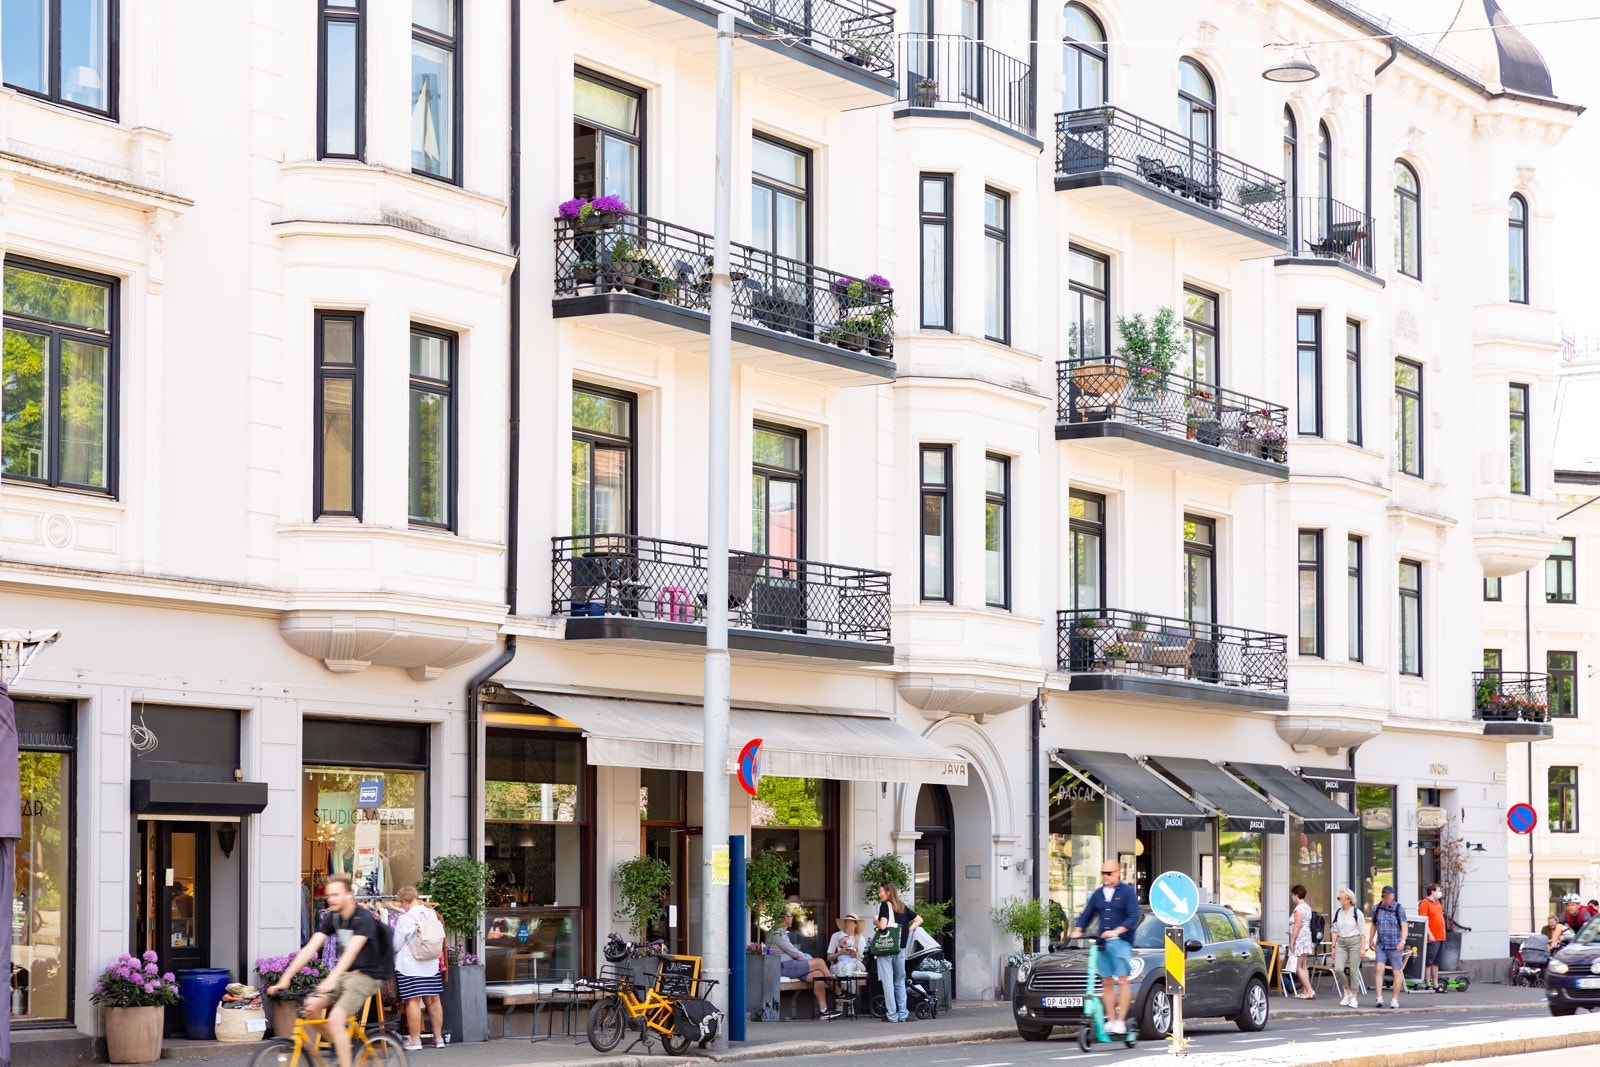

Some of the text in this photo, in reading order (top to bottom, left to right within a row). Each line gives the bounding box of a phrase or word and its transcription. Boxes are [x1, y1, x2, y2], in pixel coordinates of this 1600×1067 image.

[943, 764, 965, 775] JAVA
[1057, 785, 1095, 805] PASCAL
[313, 808, 404, 826] STUDIOBAZAR
[1164, 817, 1183, 828] PASCAL
[1249, 820, 1265, 830] PASCAL
[1324, 822, 1340, 832] PASCAL
[1047, 998, 1081, 1006] DP 44979
